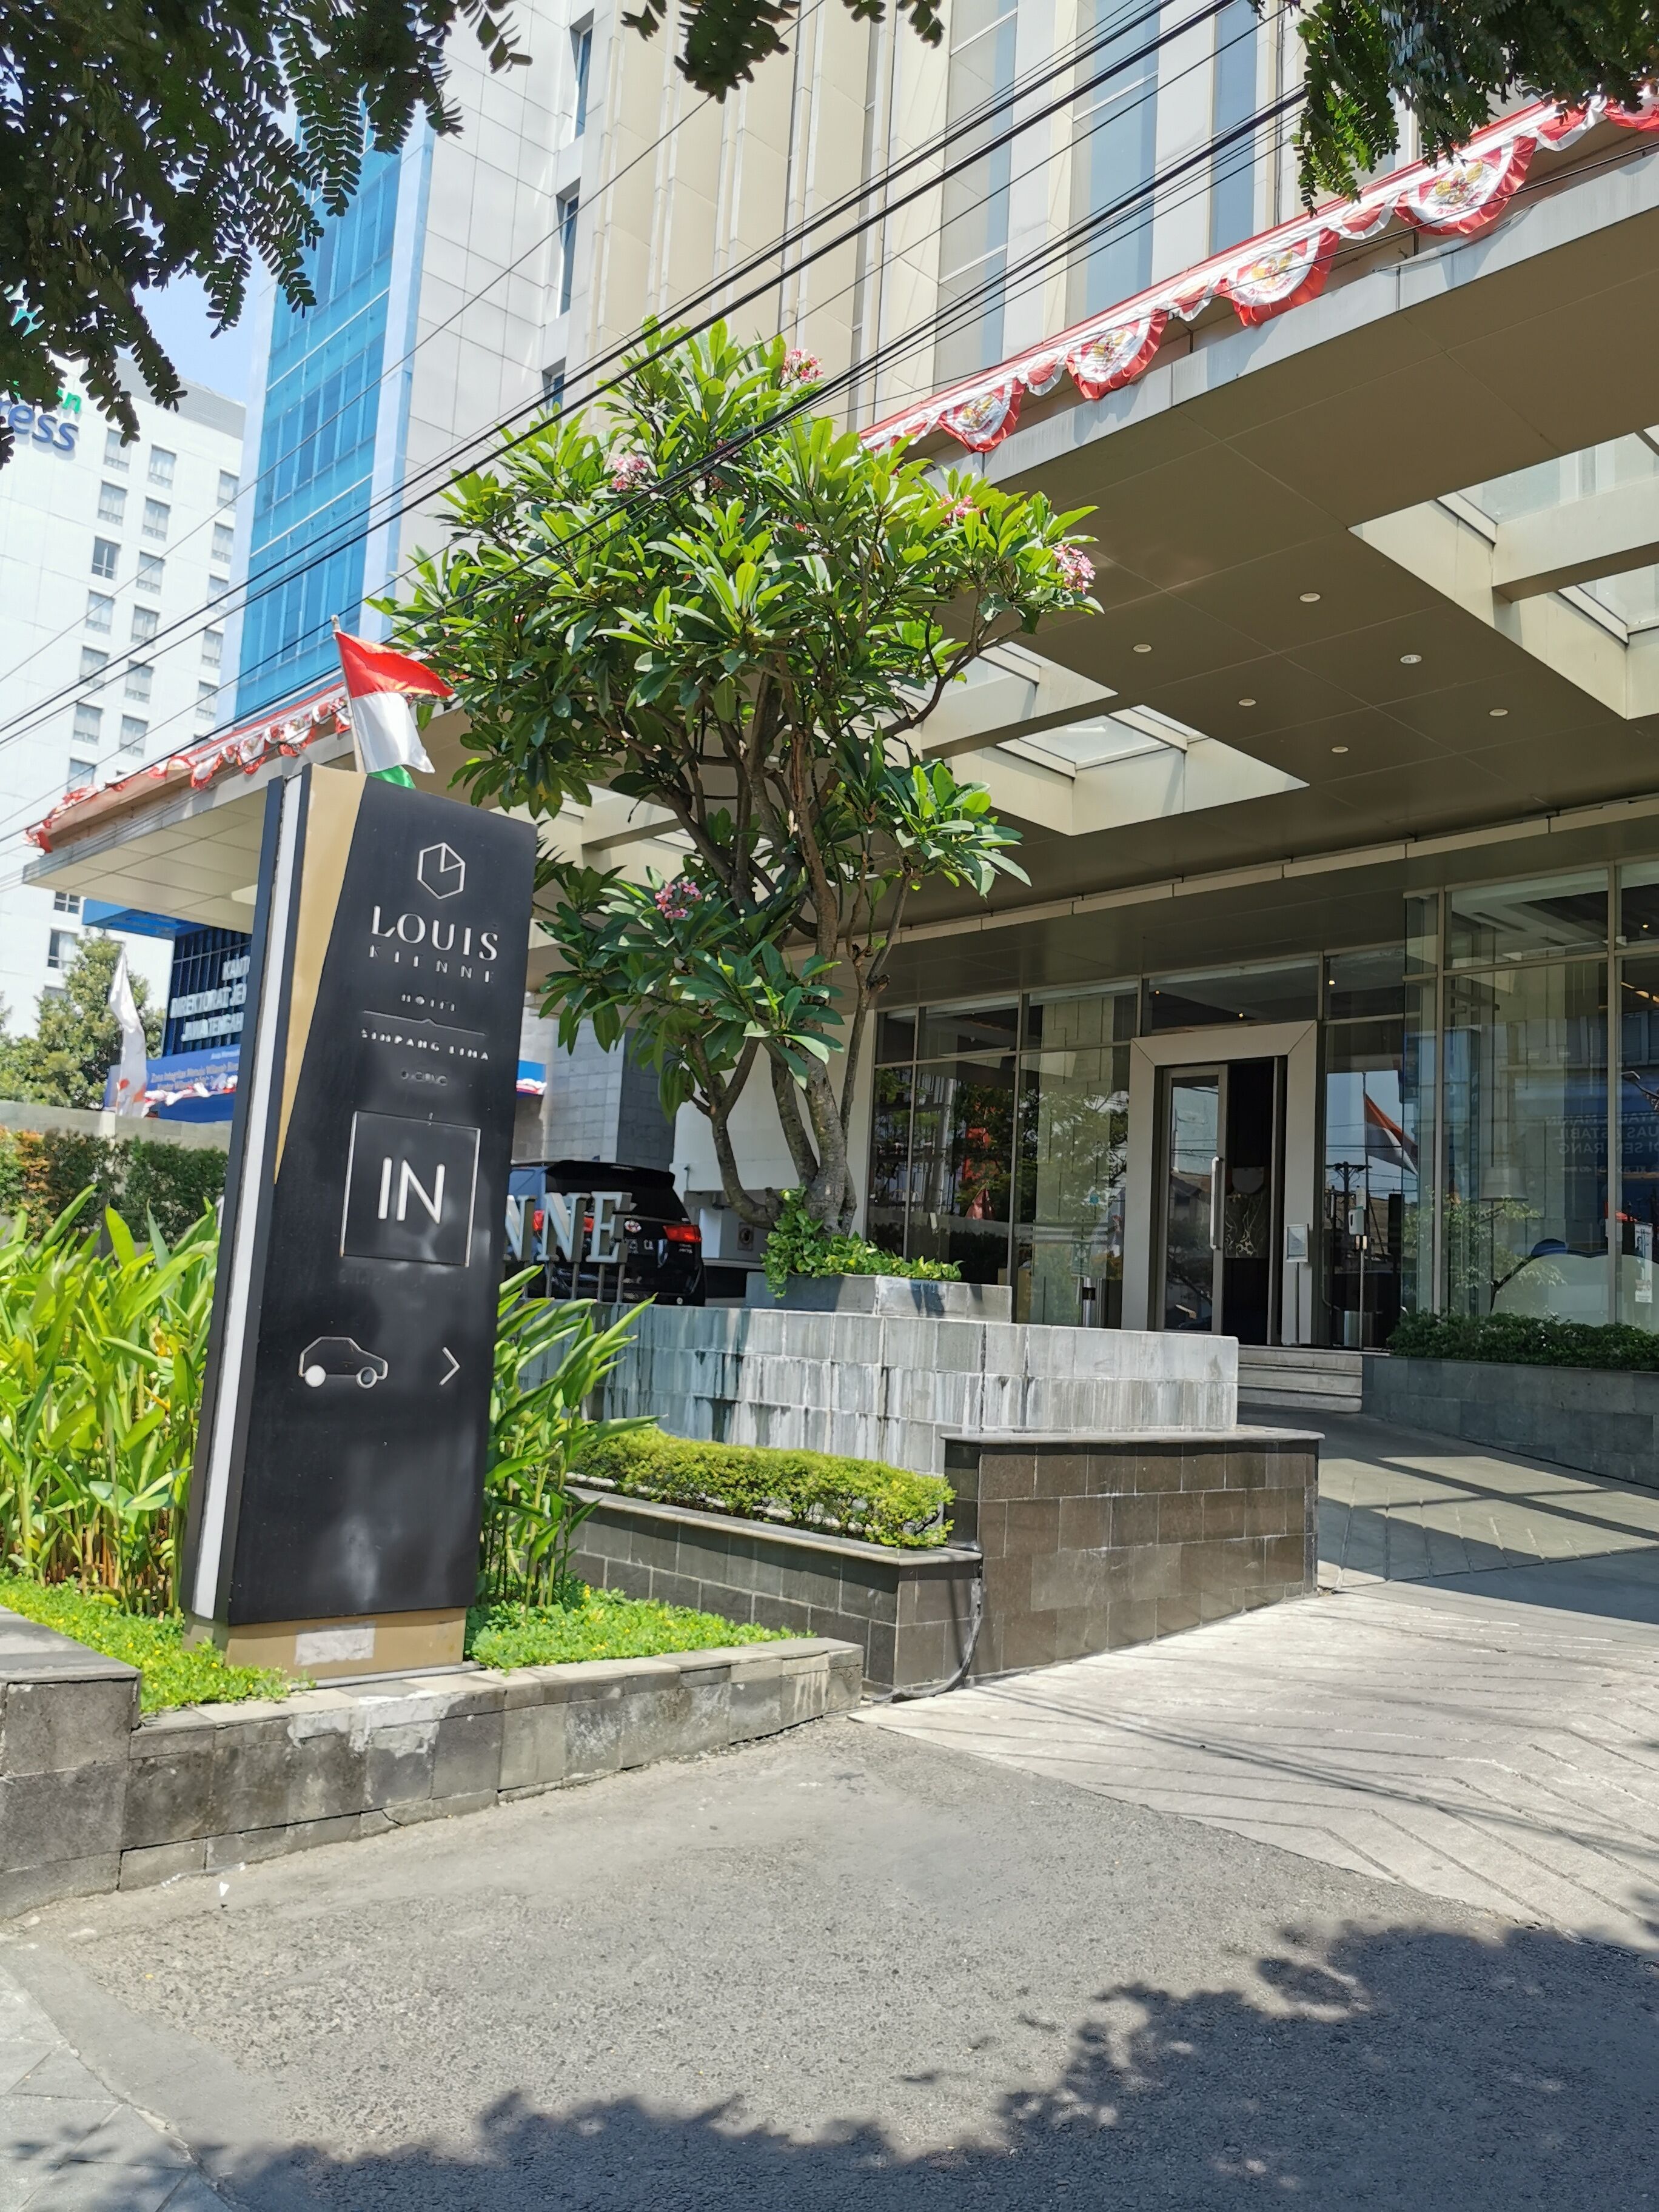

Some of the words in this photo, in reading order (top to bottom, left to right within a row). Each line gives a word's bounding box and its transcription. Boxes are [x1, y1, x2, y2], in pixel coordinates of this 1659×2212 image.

[371, 905, 498, 961] LOUIS
[361, 1028, 440, 1051] SIMPANG
[449, 1045, 489, 1060] LIMA
[378, 1156, 446, 1224] IN
